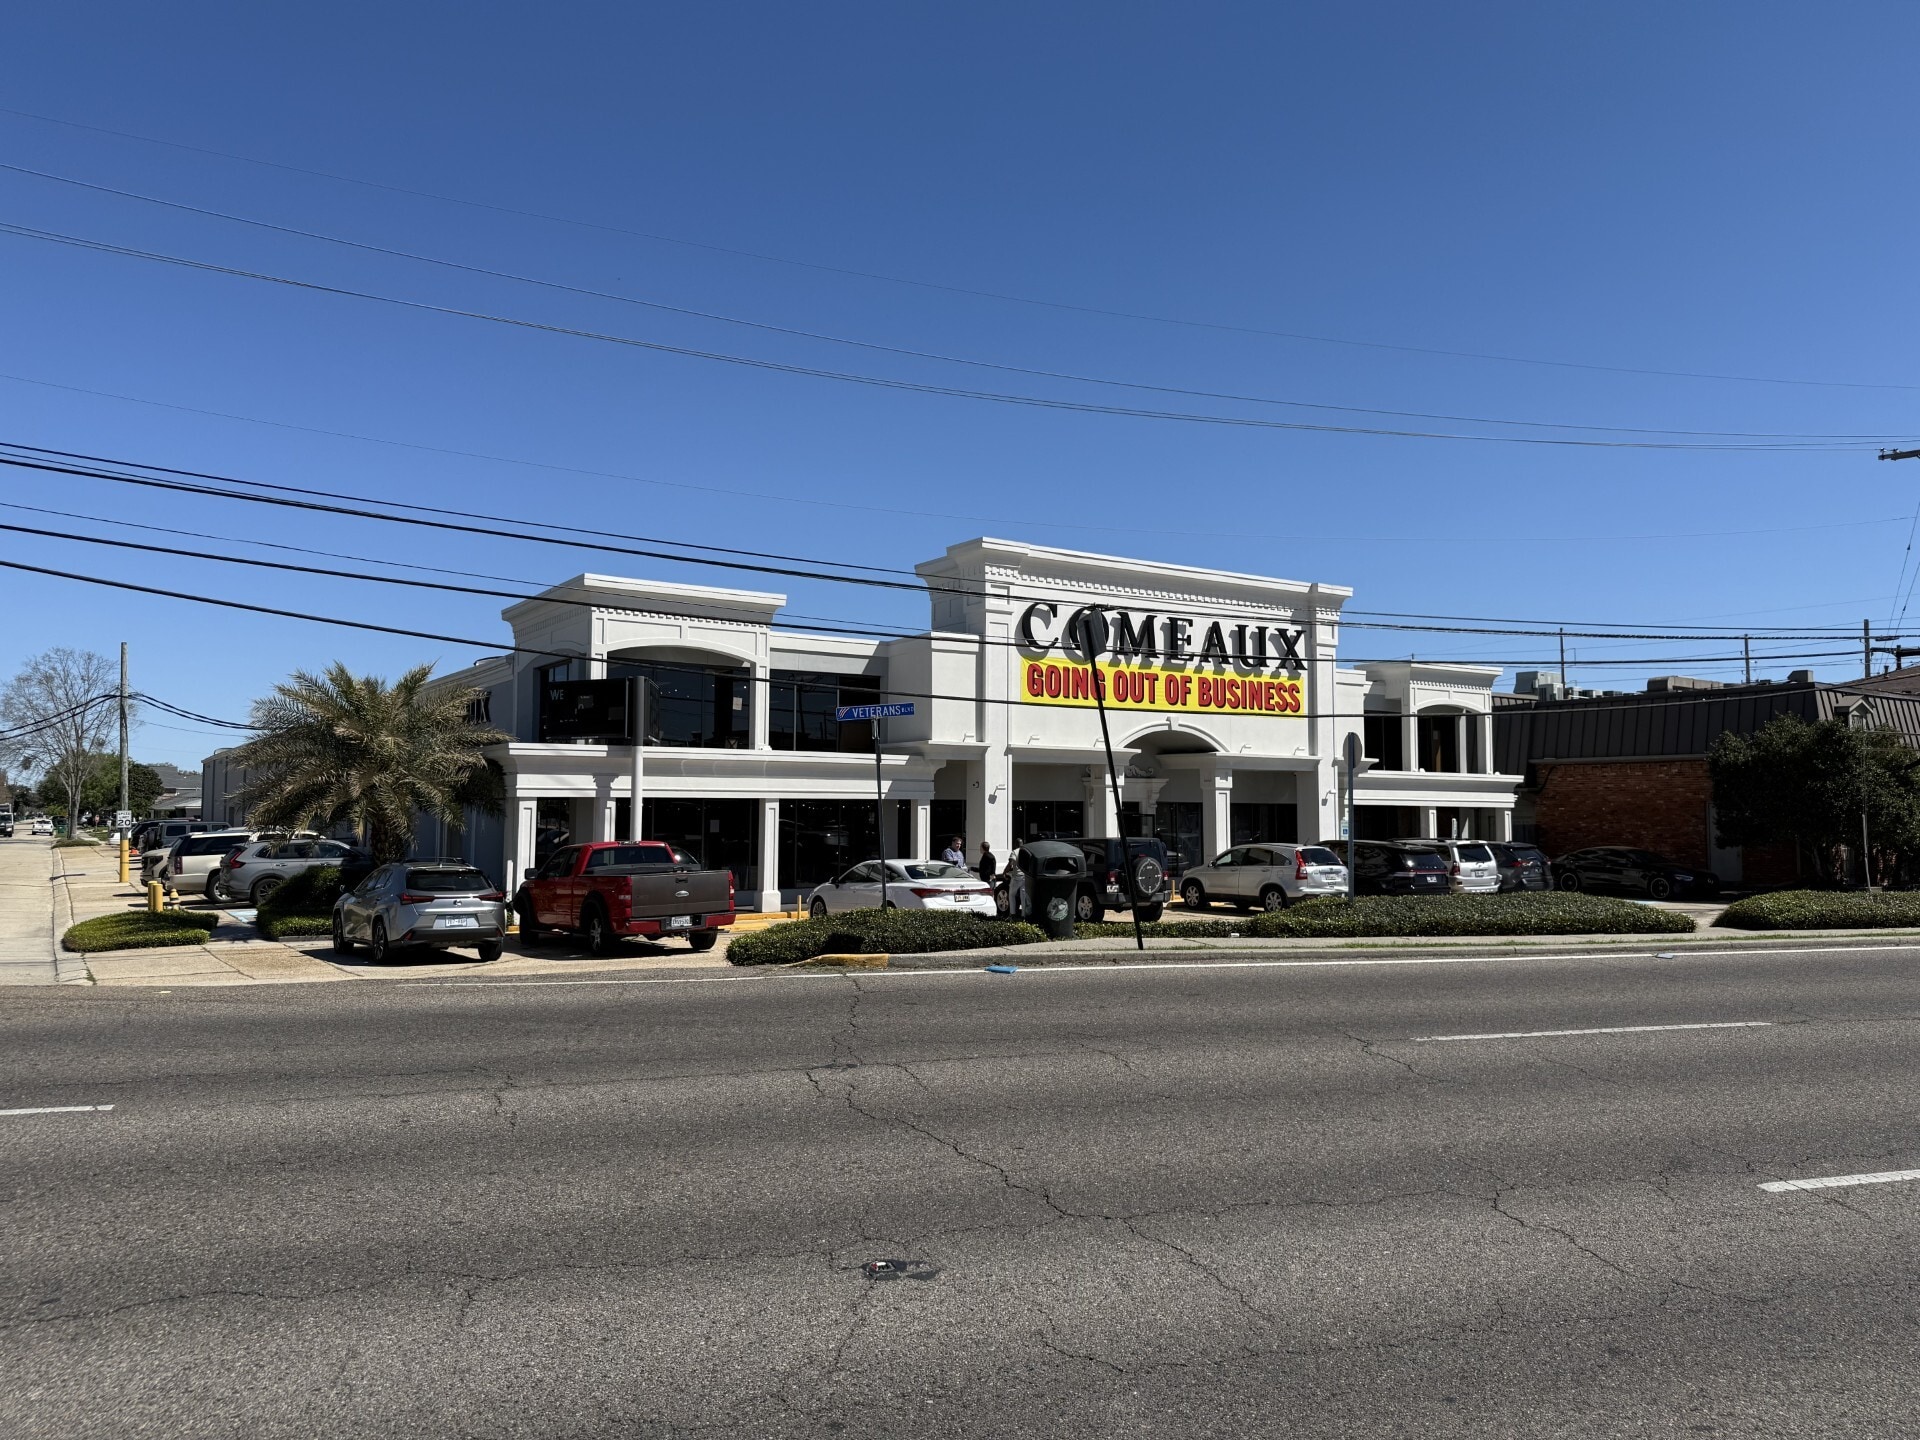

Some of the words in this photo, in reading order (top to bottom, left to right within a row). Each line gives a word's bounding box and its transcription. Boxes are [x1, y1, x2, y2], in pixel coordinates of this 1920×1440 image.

[1021, 602, 1308, 670] COMEAUX
[550, 689, 565, 701] WE
[1026, 663, 1106, 701] GOING
[1112, 670, 1159, 704] OUT
[1164, 674, 1192, 705] OF
[1198, 676, 1301, 712] BUSINESS
[852, 705, 901, 718] VETERANS
